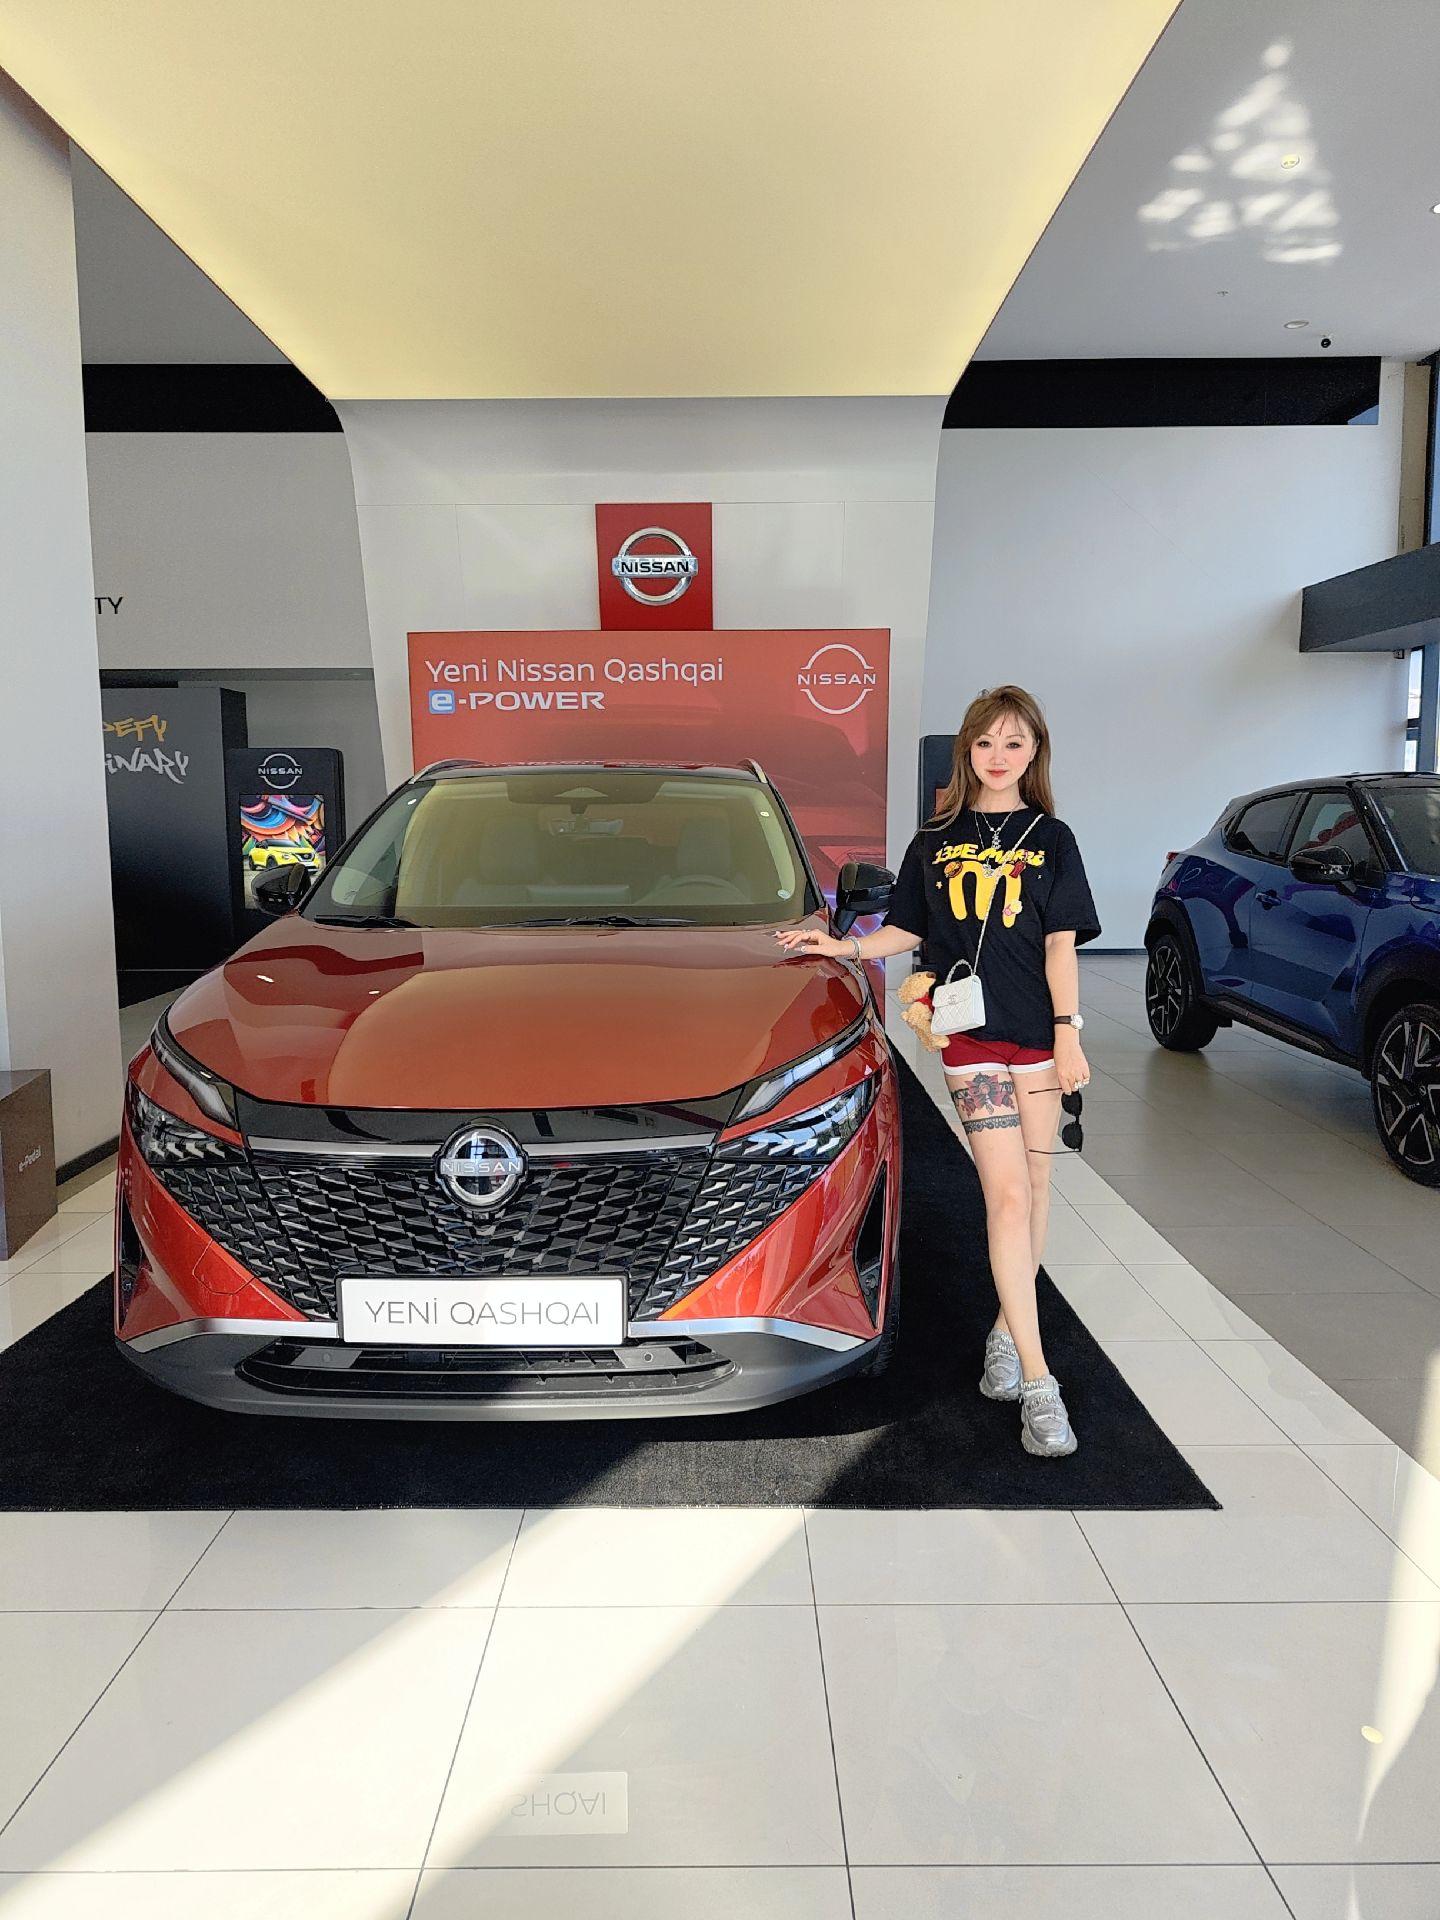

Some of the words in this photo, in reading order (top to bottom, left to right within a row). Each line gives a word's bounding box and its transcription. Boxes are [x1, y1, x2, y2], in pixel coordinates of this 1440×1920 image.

[621, 561, 689, 573] NISSAN
[425, 659, 488, 683] Yeni
[497, 658, 595, 683] Nissan
[603, 657, 724, 687] Qashqai
[797, 673, 876, 685] NISSAN
[428, 690, 606, 714] e-POWER
[257, 767, 303, 775] NISSAN
[441, 1160, 521, 1174] NISSAN
[450, 1300, 599, 1326] QASHQAI
